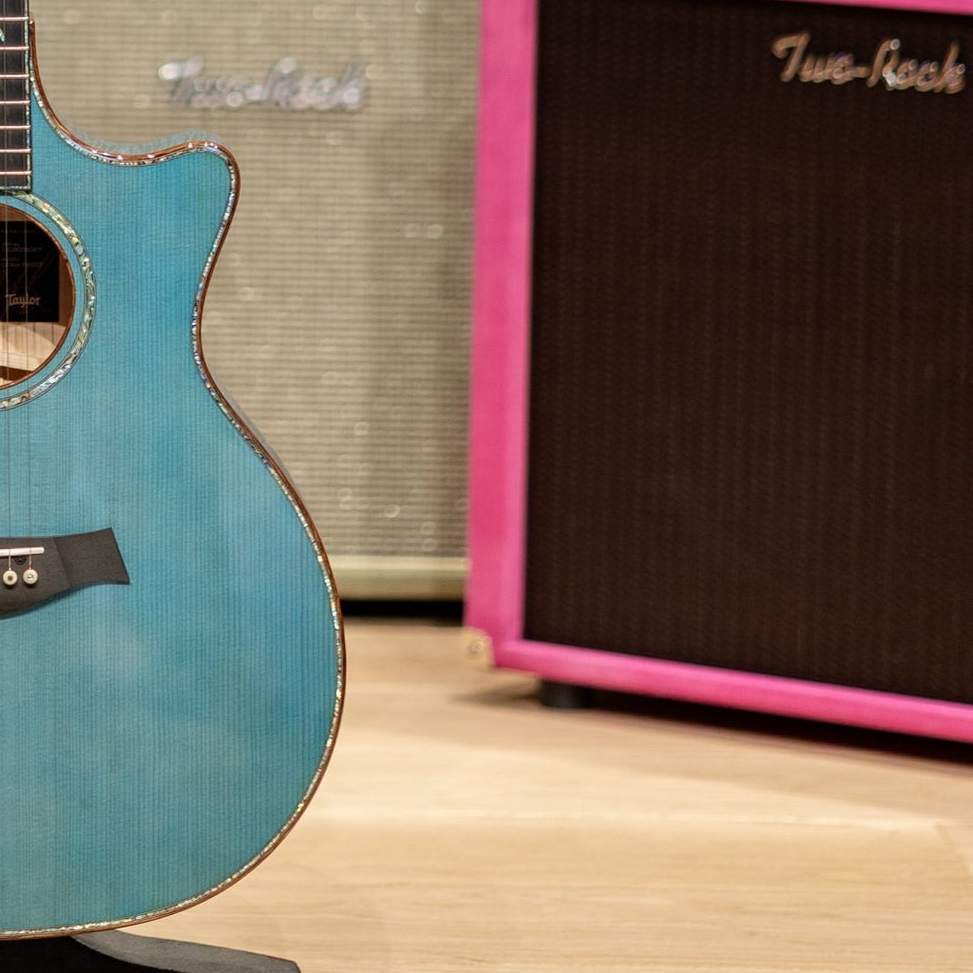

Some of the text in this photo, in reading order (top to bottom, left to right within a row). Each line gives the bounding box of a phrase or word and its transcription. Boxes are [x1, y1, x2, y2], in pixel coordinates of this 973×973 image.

[158, 55, 367, 111] Two-Rock
[771, 30, 966, 94] Two-Rock
[5, 293, 41, 309] Taylor
